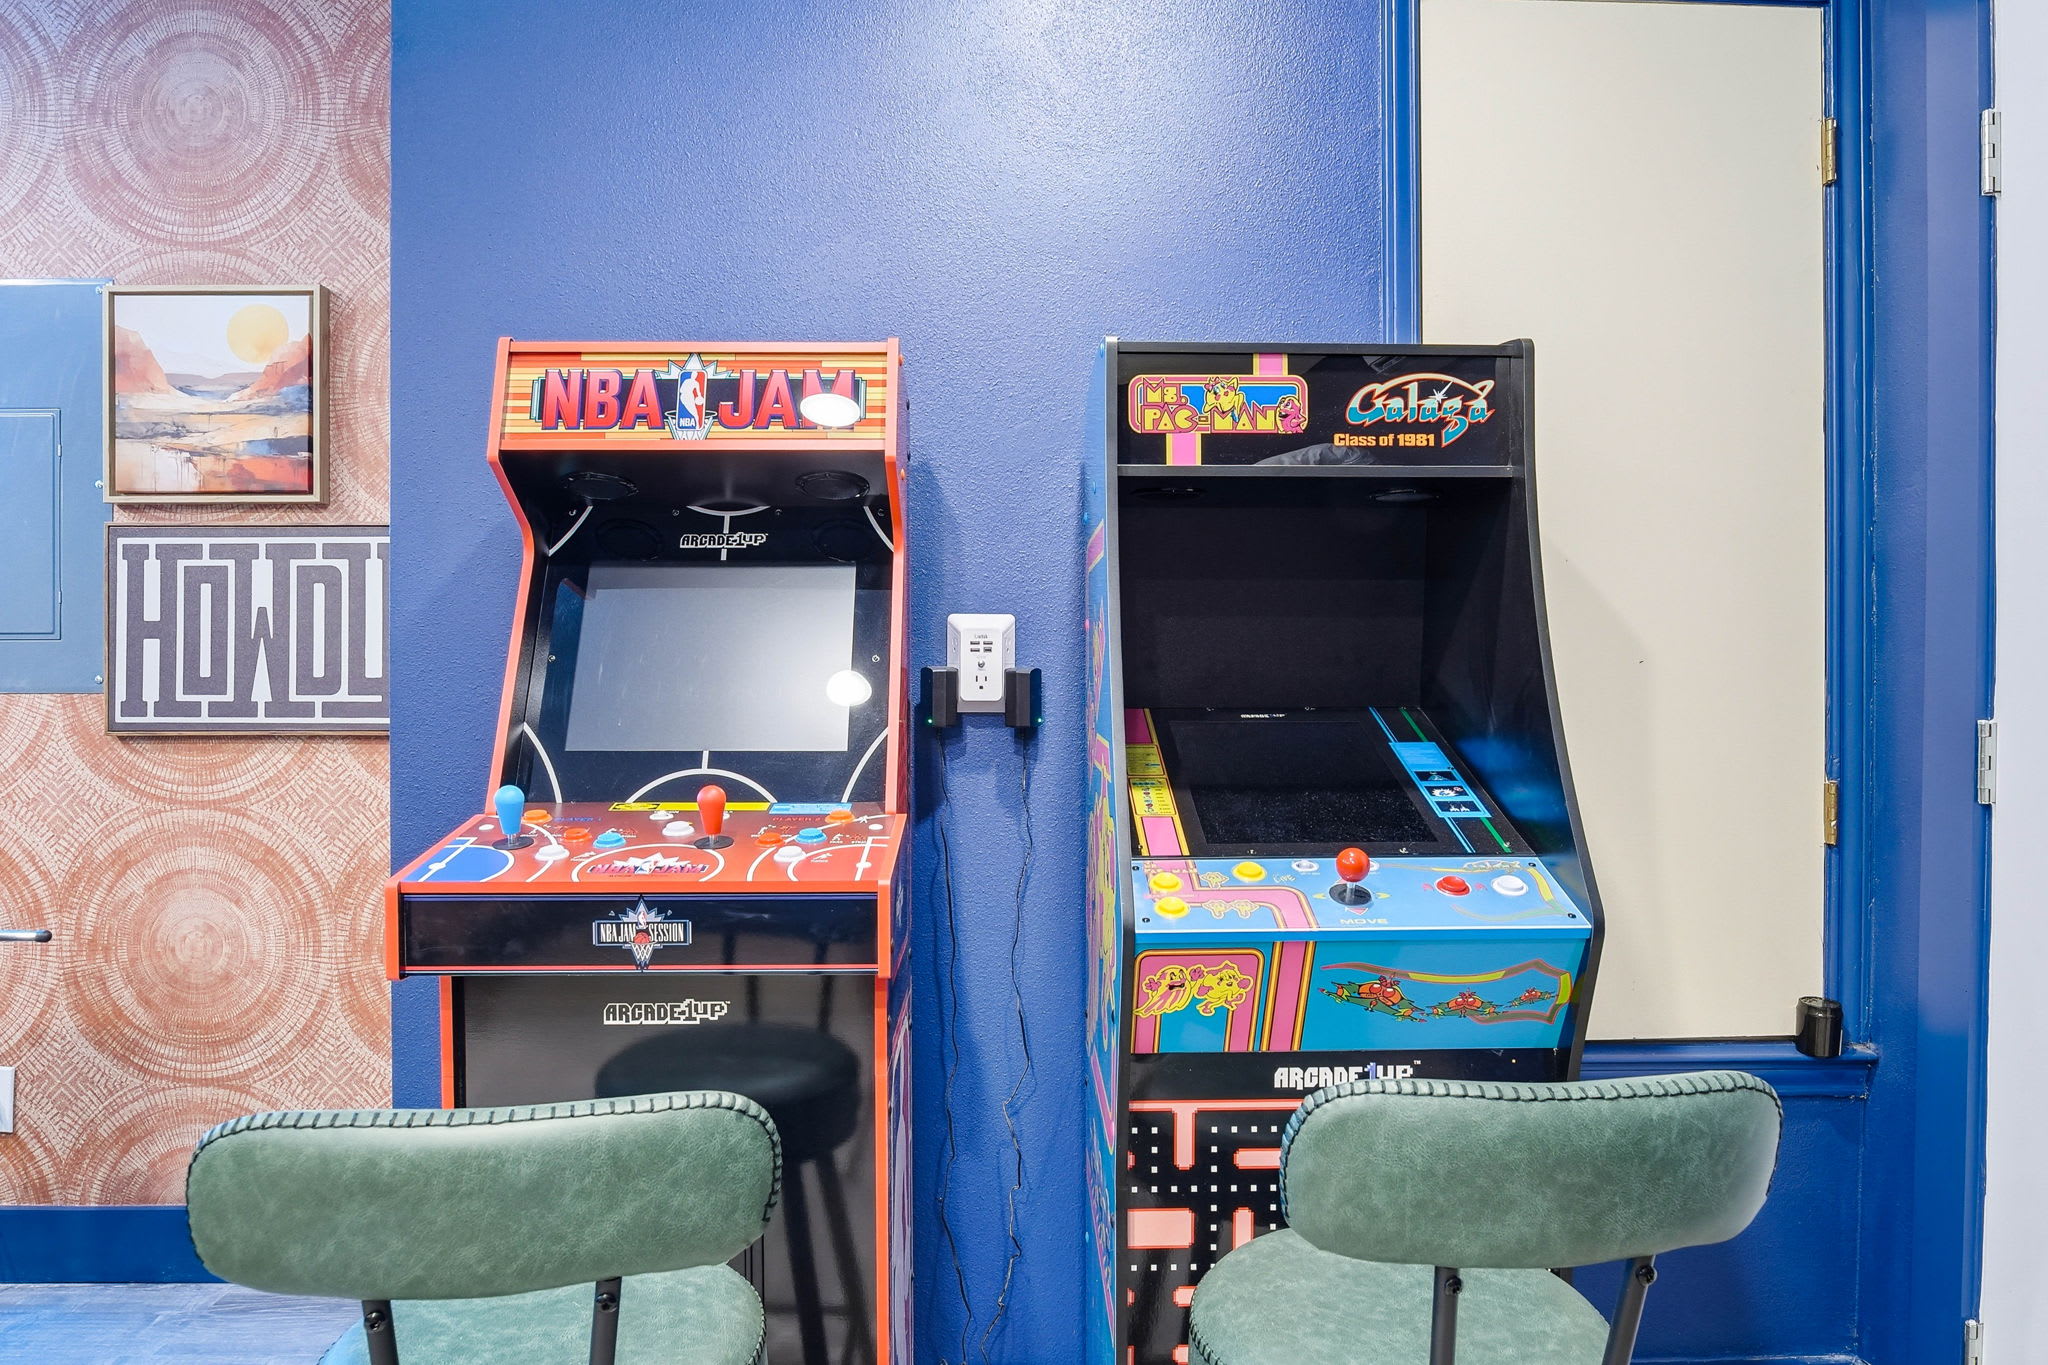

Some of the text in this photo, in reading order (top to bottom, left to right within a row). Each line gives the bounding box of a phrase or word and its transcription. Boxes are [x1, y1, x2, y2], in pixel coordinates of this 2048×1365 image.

[541, 369, 665, 430] NBA
[679, 417, 696, 428] NBA
[1333, 433, 1435, 447] Class of 1981
[600, 922, 685, 942] NBA JAM SESSION
